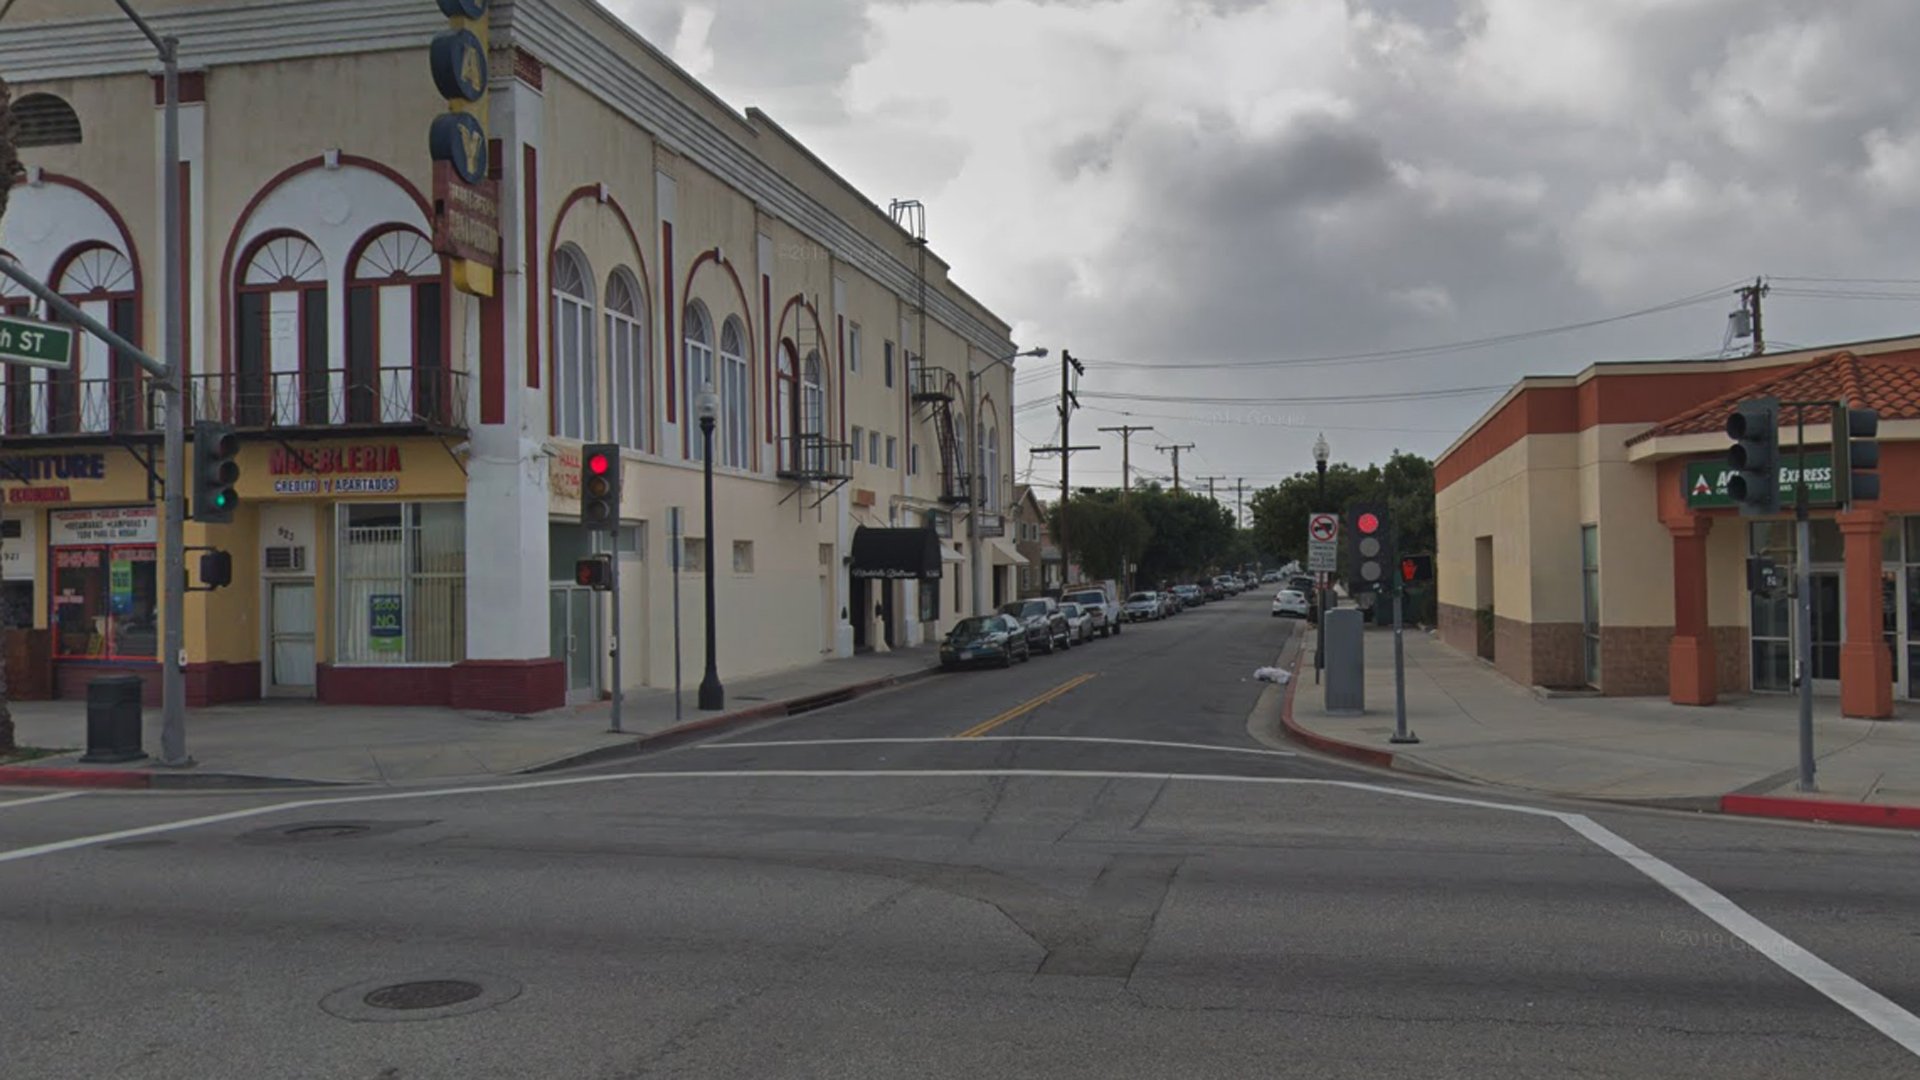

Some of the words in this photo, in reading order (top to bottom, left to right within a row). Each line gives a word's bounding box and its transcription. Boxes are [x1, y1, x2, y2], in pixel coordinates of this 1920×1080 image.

[19, 330, 45, 353] ST
[269, 444, 402, 475] MUEBLERIA
[274, 479, 319, 493] CREDITO
[323, 479, 332, 493] Y
[335, 477, 399, 492] APARTADOS
